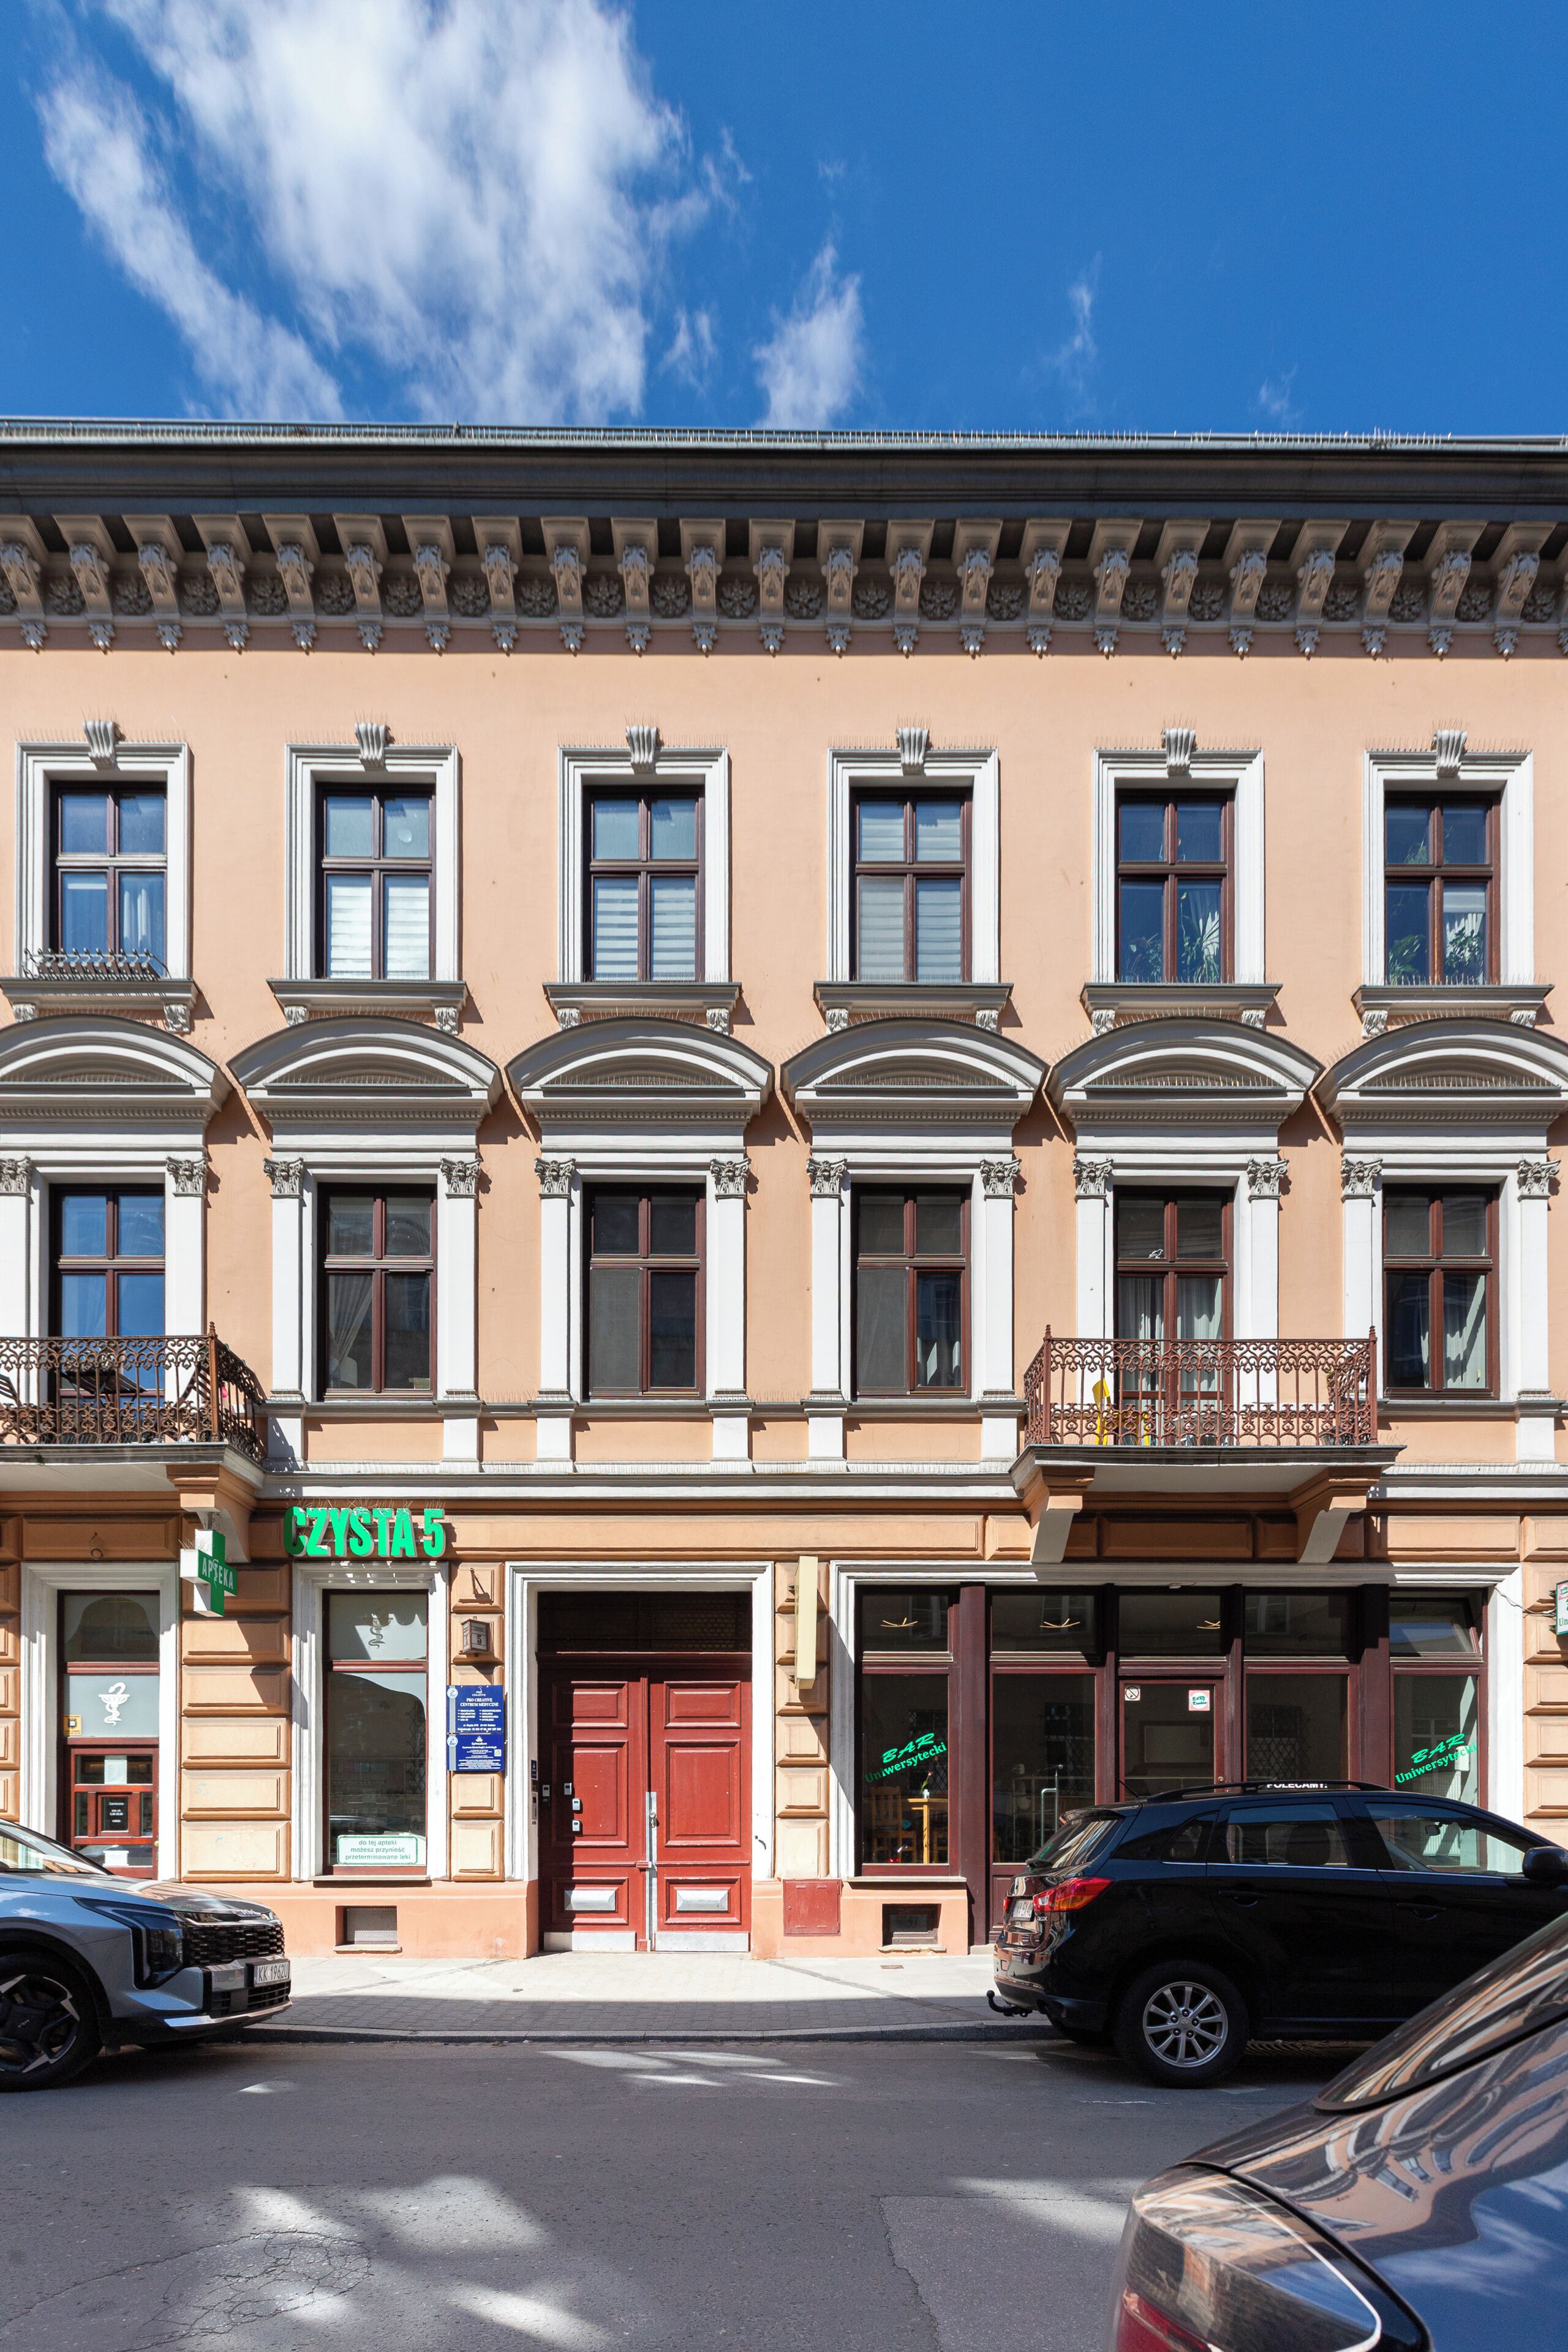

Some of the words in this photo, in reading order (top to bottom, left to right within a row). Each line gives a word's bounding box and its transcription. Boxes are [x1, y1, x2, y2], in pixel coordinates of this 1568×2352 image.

[284, 1506, 418, 1556] CZYSTA
[423, 1508, 446, 1557] 5
[202, 1557, 233, 1590] APTEKA
[864, 1742, 948, 1783] Uniwersytecki
[881, 1733, 935, 1763] BAR
[1395, 1741, 1478, 1784] Uniwersytecki
[1411, 1733, 1465, 1763] BAR
[258, 1966, 268, 1981] KK
[271, 1963, 288, 1980] 1962U
